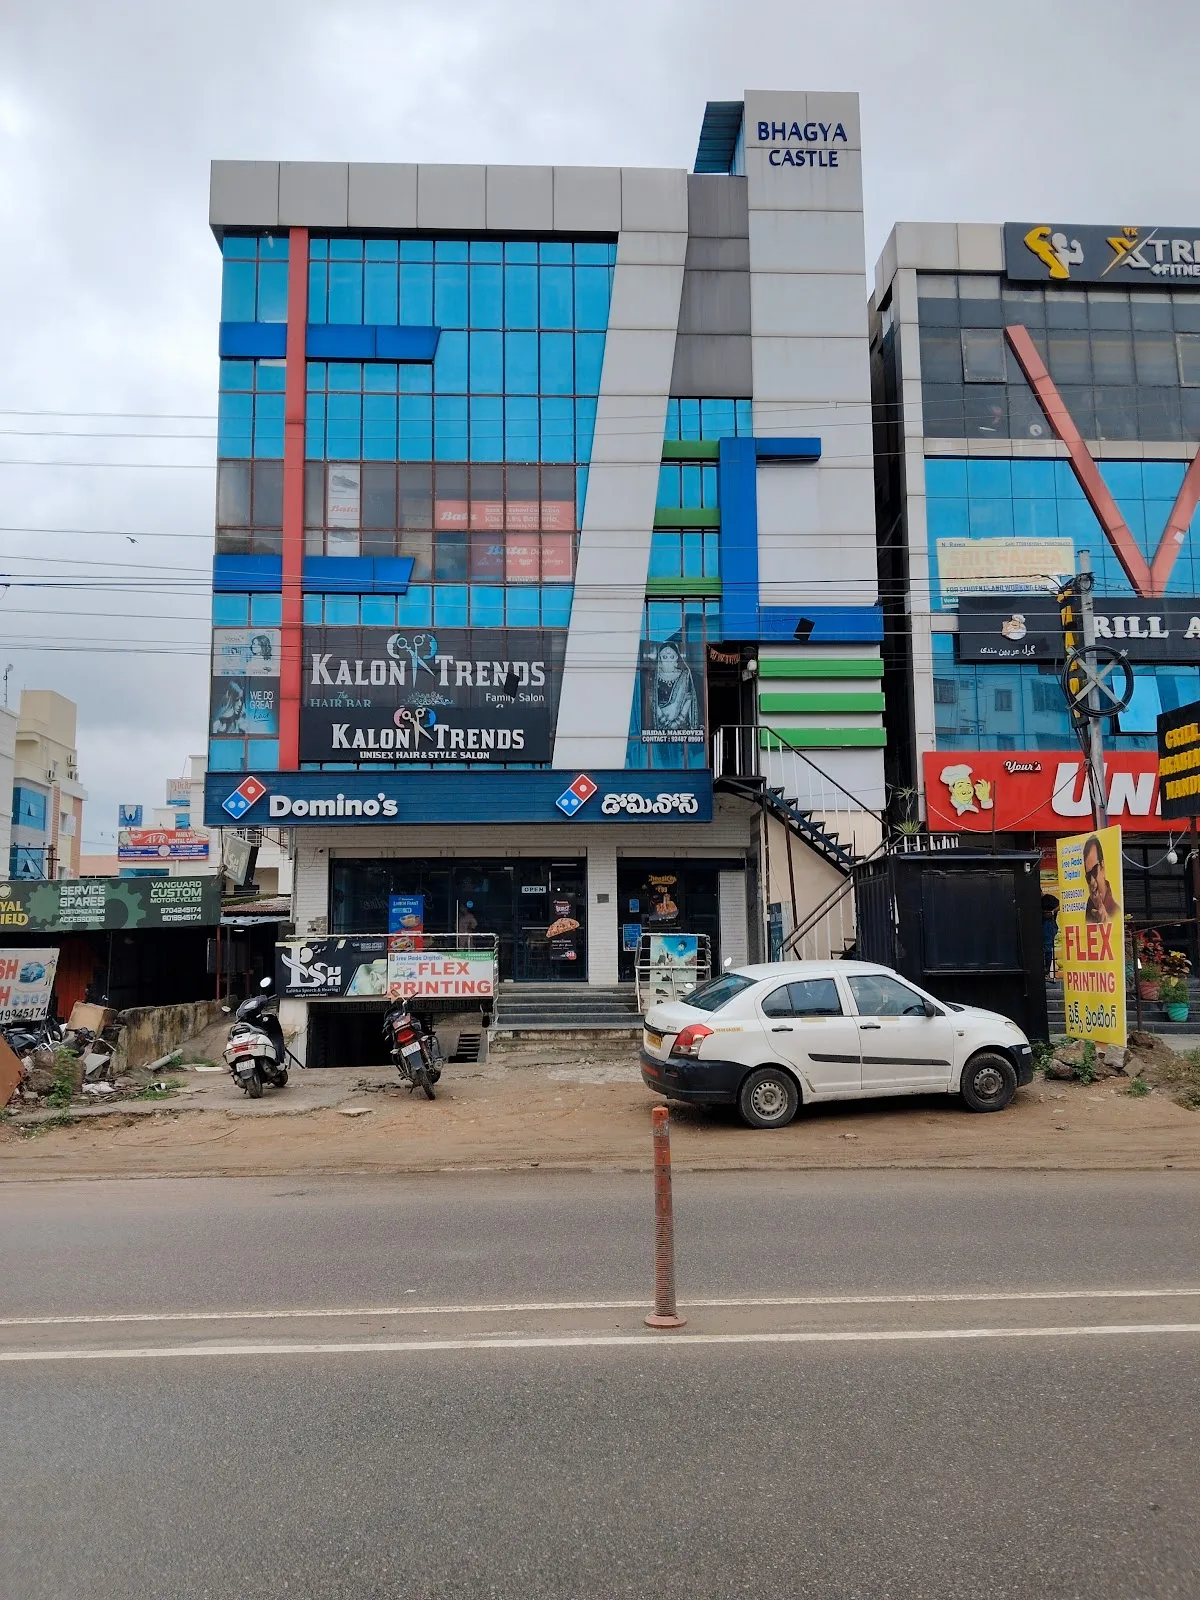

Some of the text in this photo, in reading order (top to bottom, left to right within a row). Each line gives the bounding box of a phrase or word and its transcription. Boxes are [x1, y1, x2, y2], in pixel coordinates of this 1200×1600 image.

[757, 122, 847, 141] BHAGYA
[768, 150, 838, 167] CASTLE
[1122, 227, 1138, 237] VK
[311, 654, 406, 686] KALON
[434, 655, 546, 687] TRENDS
[250, 691, 273, 700] WE DO
[518, 692, 545, 702] Salon
[249, 700, 274, 710] GREAT
[310, 698, 372, 708] HAIR BAR
[331, 723, 410, 749] KALON
[433, 724, 525, 749] TRENDS
[359, 751, 394, 760] UNISEX
[460, 751, 490, 760] SALON
[1004, 760, 1042, 773] Your's
[1051, 762, 1161, 816] UN
[269, 792, 398, 817] Domino's
[145, 834, 166, 844] AVR
[60, 885, 105, 896] SERVICE
[151, 881, 202, 889] VANGUARD
[150, 888, 202, 898] CUSTOM
[60, 897, 105, 907] SPARES
[1065, 923, 1114, 961] FLEX
[418, 962, 469, 975] FLEX
[390, 980, 491, 994] PRINTING
[1066, 971, 1116, 994] PRINTING
